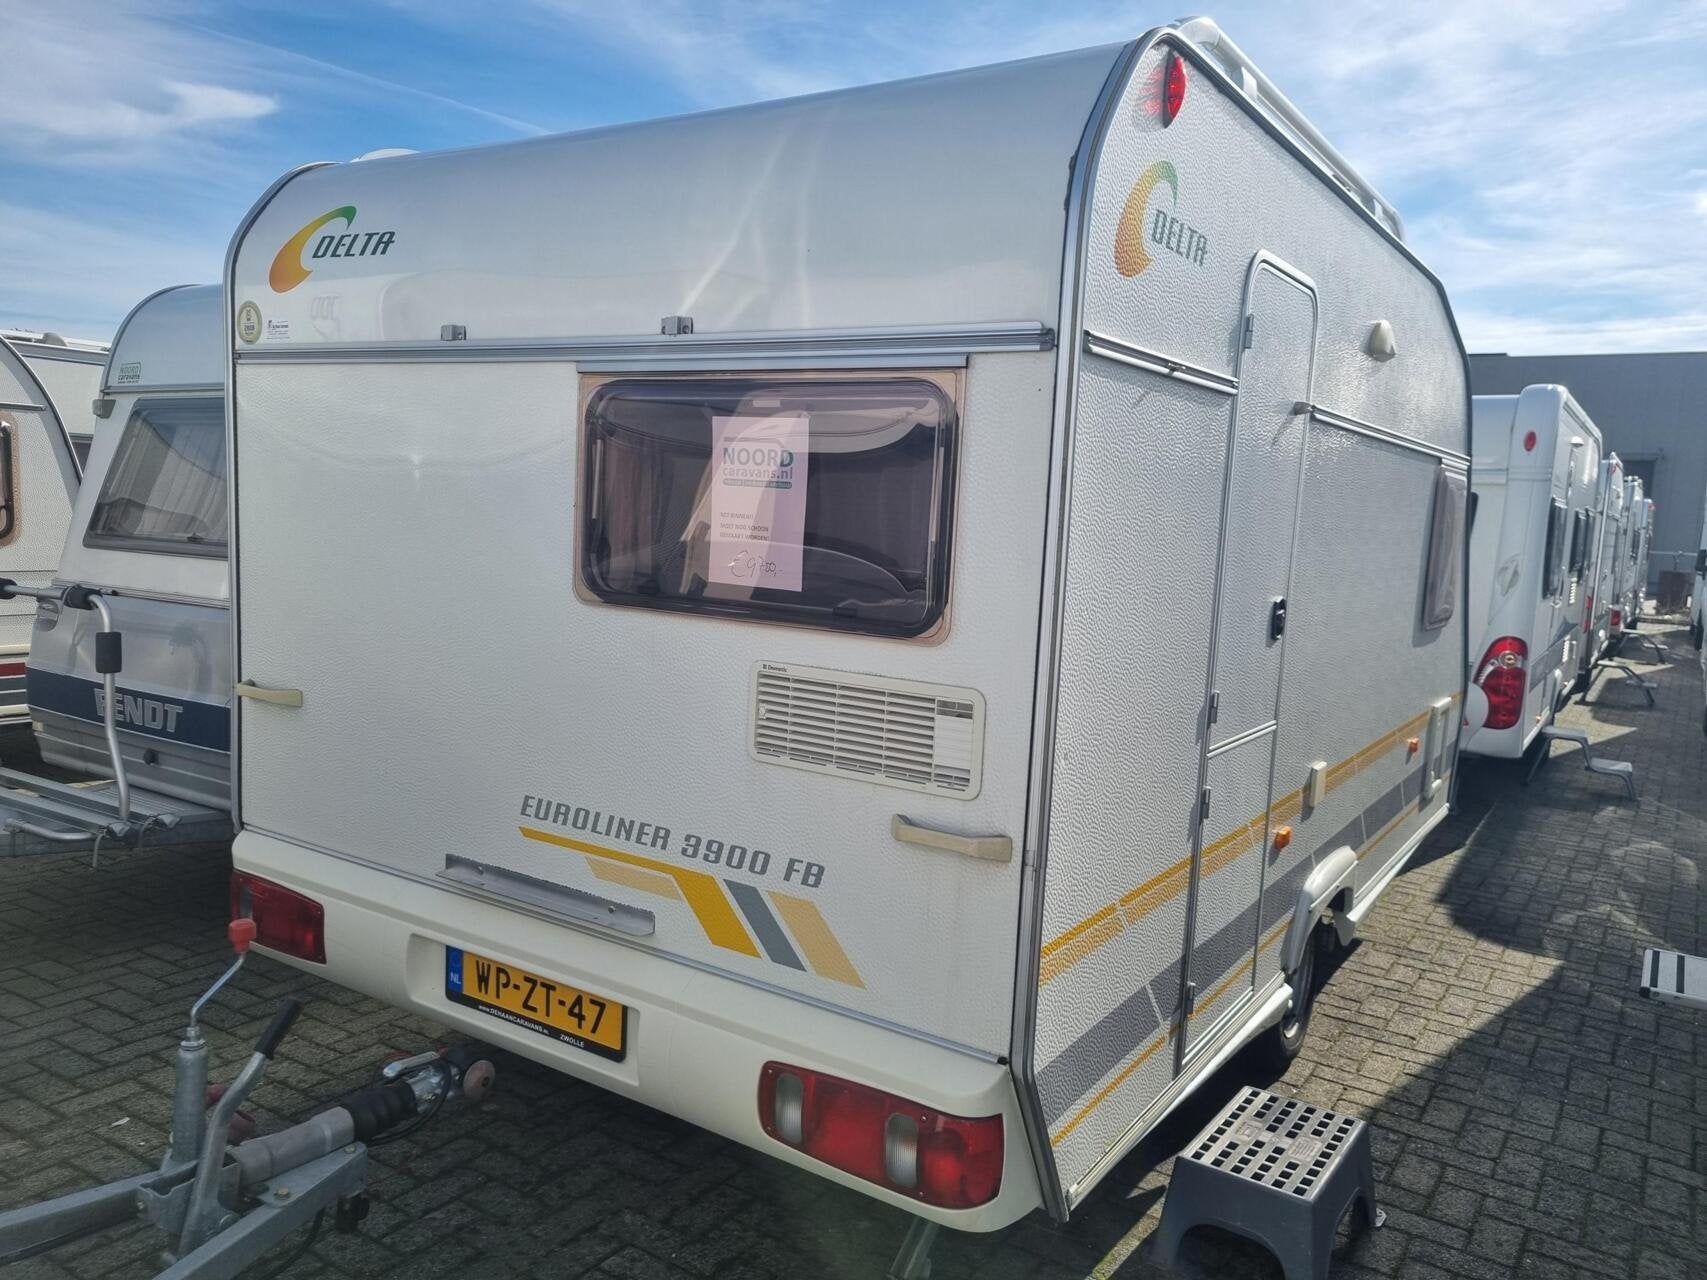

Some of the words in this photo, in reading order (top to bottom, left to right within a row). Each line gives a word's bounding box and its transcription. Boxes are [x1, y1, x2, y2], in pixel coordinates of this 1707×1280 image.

[312, 230, 395, 259] DELTA
[1151, 209, 1208, 266] DELTA
[722, 447, 794, 467] NOORD
[722, 467, 793, 480] caravans.nl
[94, 688, 183, 733] FENDT
[520, 794, 671, 850] EUROLINER
[681, 833, 771, 876] 3900
[783, 856, 826, 889] FB
[450, 971, 462, 985] NL
[475, 959, 607, 1035] WP-ZT-47
[560, 1033, 585, 1048] ZWOLLE
